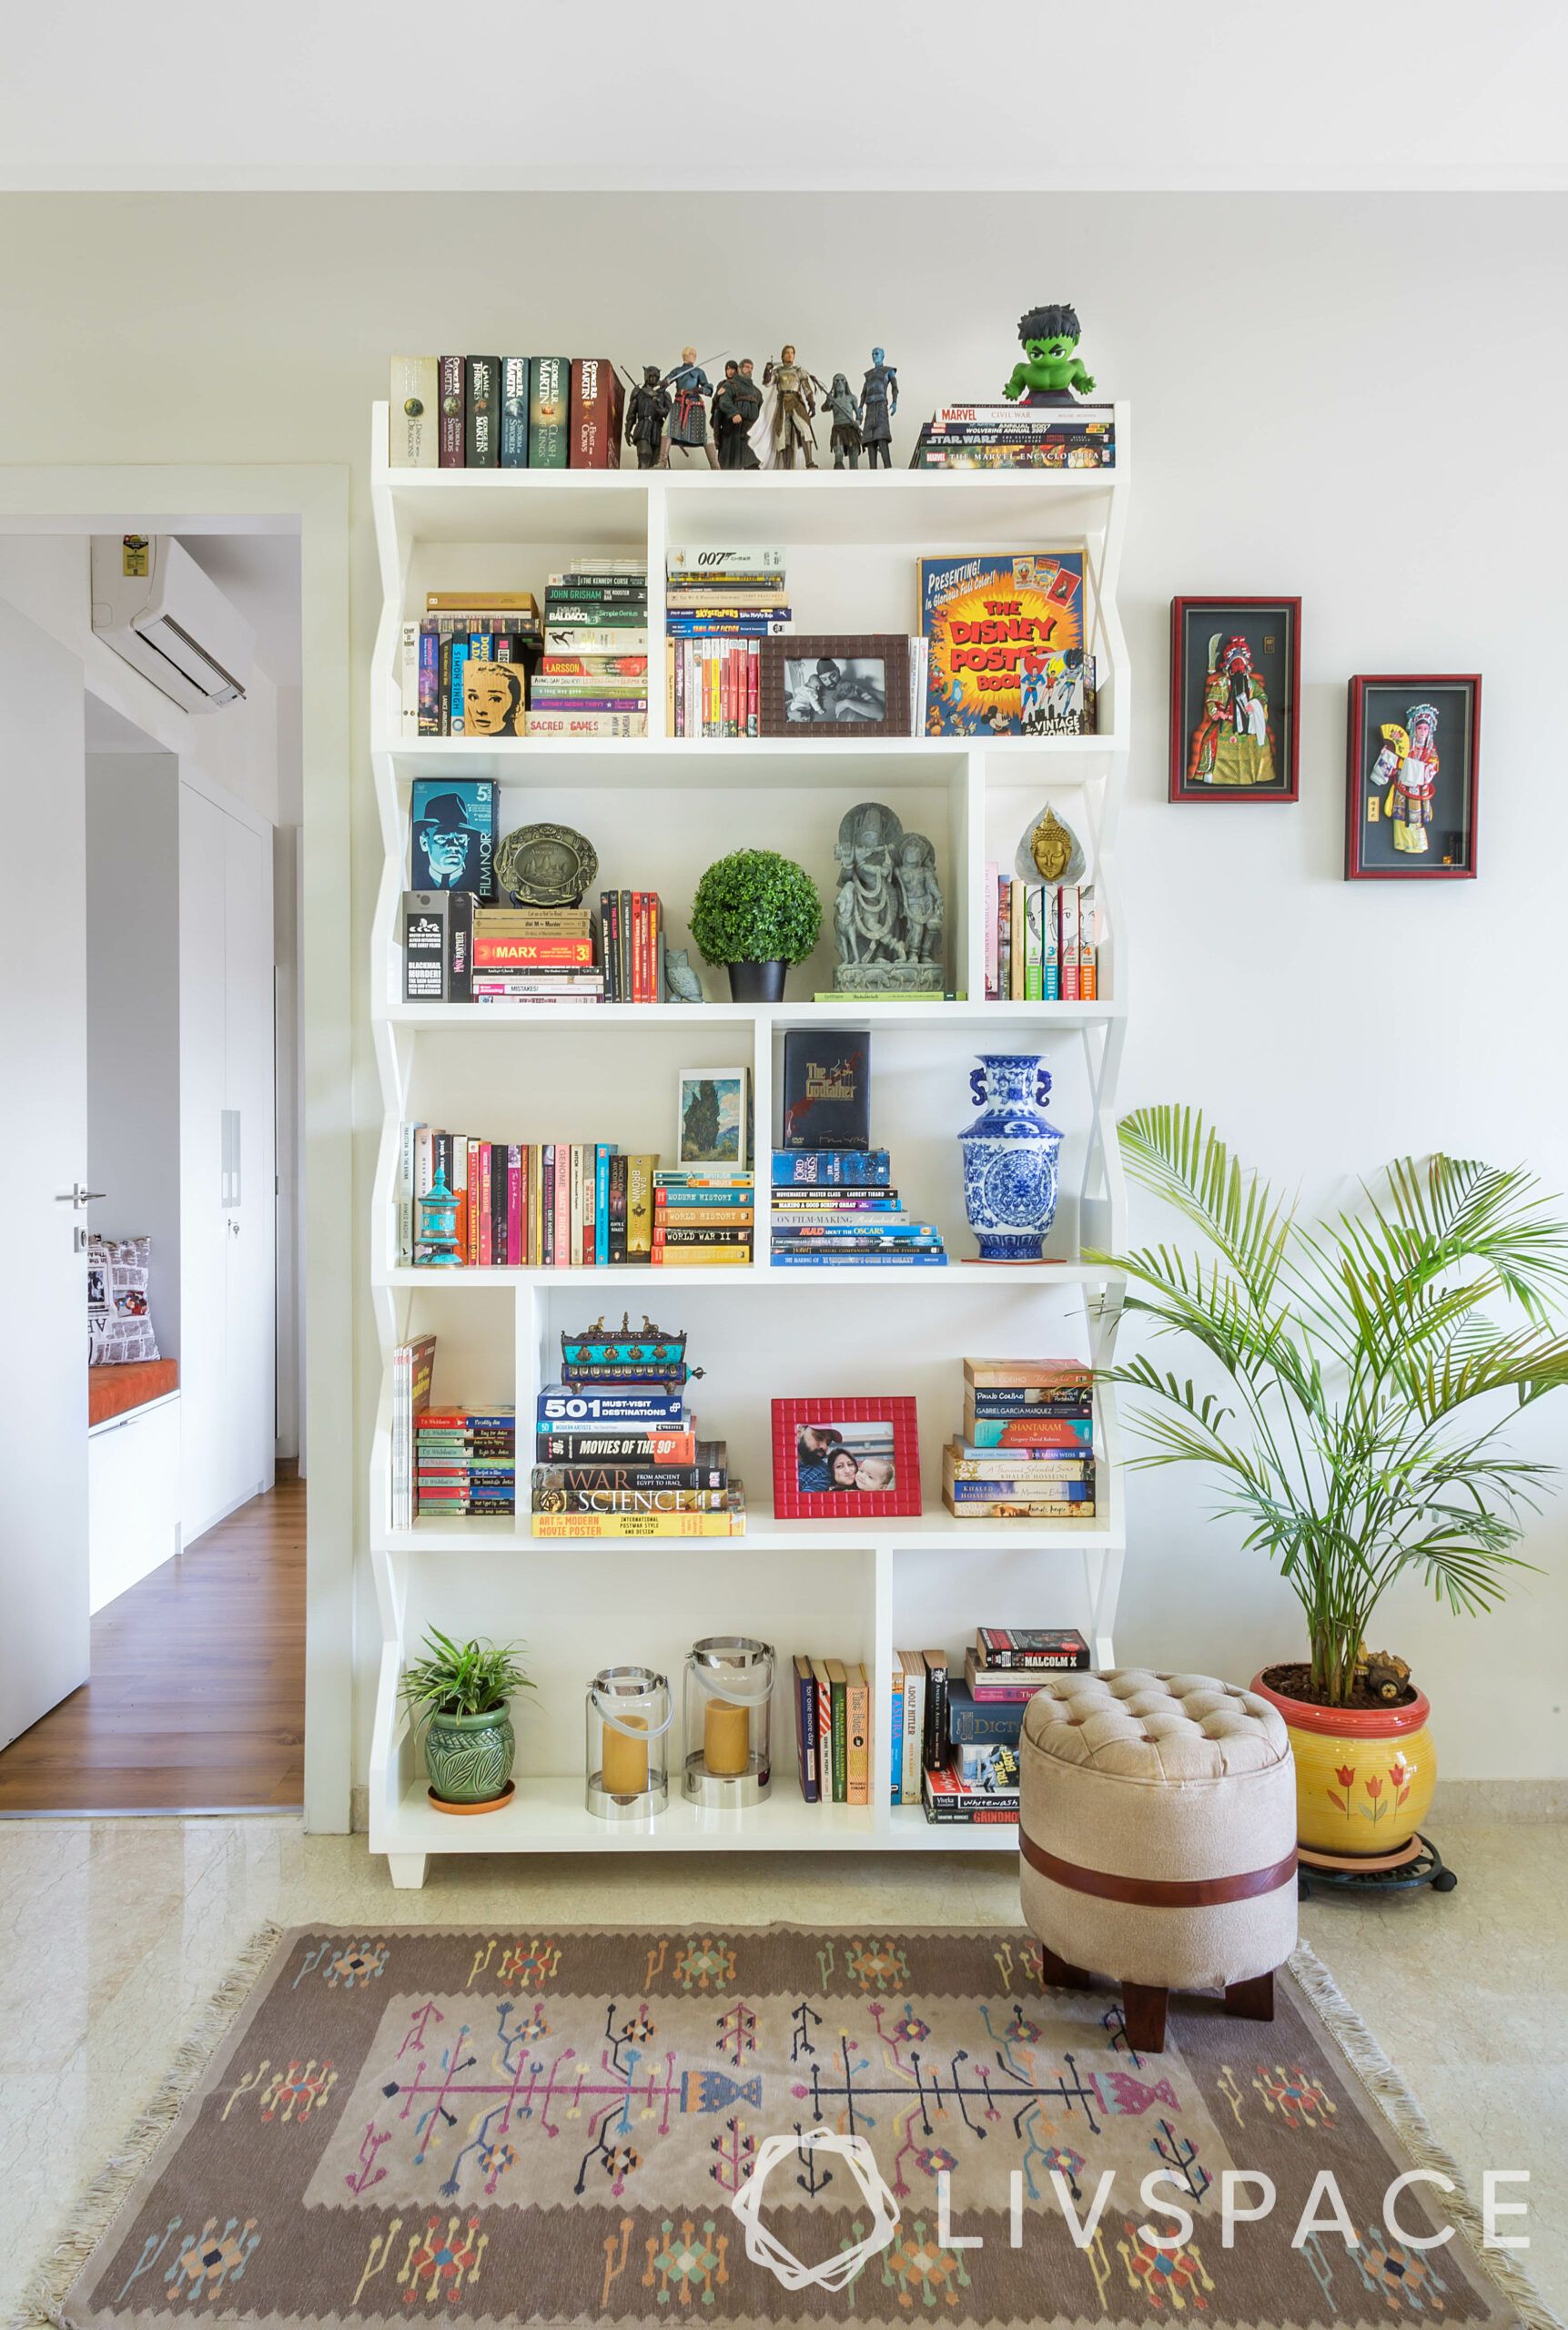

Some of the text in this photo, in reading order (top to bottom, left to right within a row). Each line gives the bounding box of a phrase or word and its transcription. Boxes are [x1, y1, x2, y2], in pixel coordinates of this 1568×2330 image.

[444, 357, 453, 395] MARTIN
[472, 361, 483, 400] THRONES
[482, 365, 491, 392] GAME
[506, 358, 517, 397] MARTIN
[539, 359, 551, 405] MARTIN
[582, 361, 591, 400] MARTIN
[942, 409, 976, 421] MARVEL
[407, 419, 415, 457] DRAGONS
[447, 417, 455, 452] SWORDS
[509, 419, 518, 454] SWORDS
[926, 435, 998, 444] STAR WARS
[927, 452, 946, 461] MARVEL
[698, 552, 733, 565] 007
[928, 559, 981, 594] PRESENTING!
[550, 590, 601, 599] JOHN GRISHAM
[983, 600, 1022, 616] THE
[950, 617, 1057, 646] DISNEY
[546, 664, 579, 673] LARSSON
[531, 721, 598, 731] SACRED GAMES
[1035, 715, 1080, 731] VINTAGE
[476, 786, 488, 801] 5
[480, 833, 491, 896] FILM NOIR
[455, 932, 464, 957] PANTHER
[496, 947, 537, 958] MARX
[1031, 947, 1037, 955] 1
[1047, 947, 1055, 956] 3
[1067, 947, 1075, 956] 2
[1084, 947, 1091, 956] 4
[577, 947, 586, 961] 3
[806, 1063, 826, 1079] The
[806, 1079, 858, 1098] Godfather
[794, 1160, 804, 1180] LORD
[807, 1156, 817, 1183] RINGS
[632, 1170, 640, 1202] BROWN
[544, 1399, 600, 1418] 501
[579, 1440, 620, 1454] MOVIES
[622, 1440, 635, 1454] OF
[636, 1440, 656, 1454] THE
[568, 1470, 632, 1490] WAR
[579, 1490, 686, 1511] SCIENCE
[539, 1516, 599, 1525] ART MODERN
[539, 1527, 602, 1536] MOVIE POSTER
[1025, 1657, 1077, 1667] MALCOLM X
[892, 1700, 901, 1740] ASURA
[840, 1737, 844, 1745] OF
[993, 1761, 1009, 1786] TRUE
[964, 1797, 1018, 1806] whitewash
